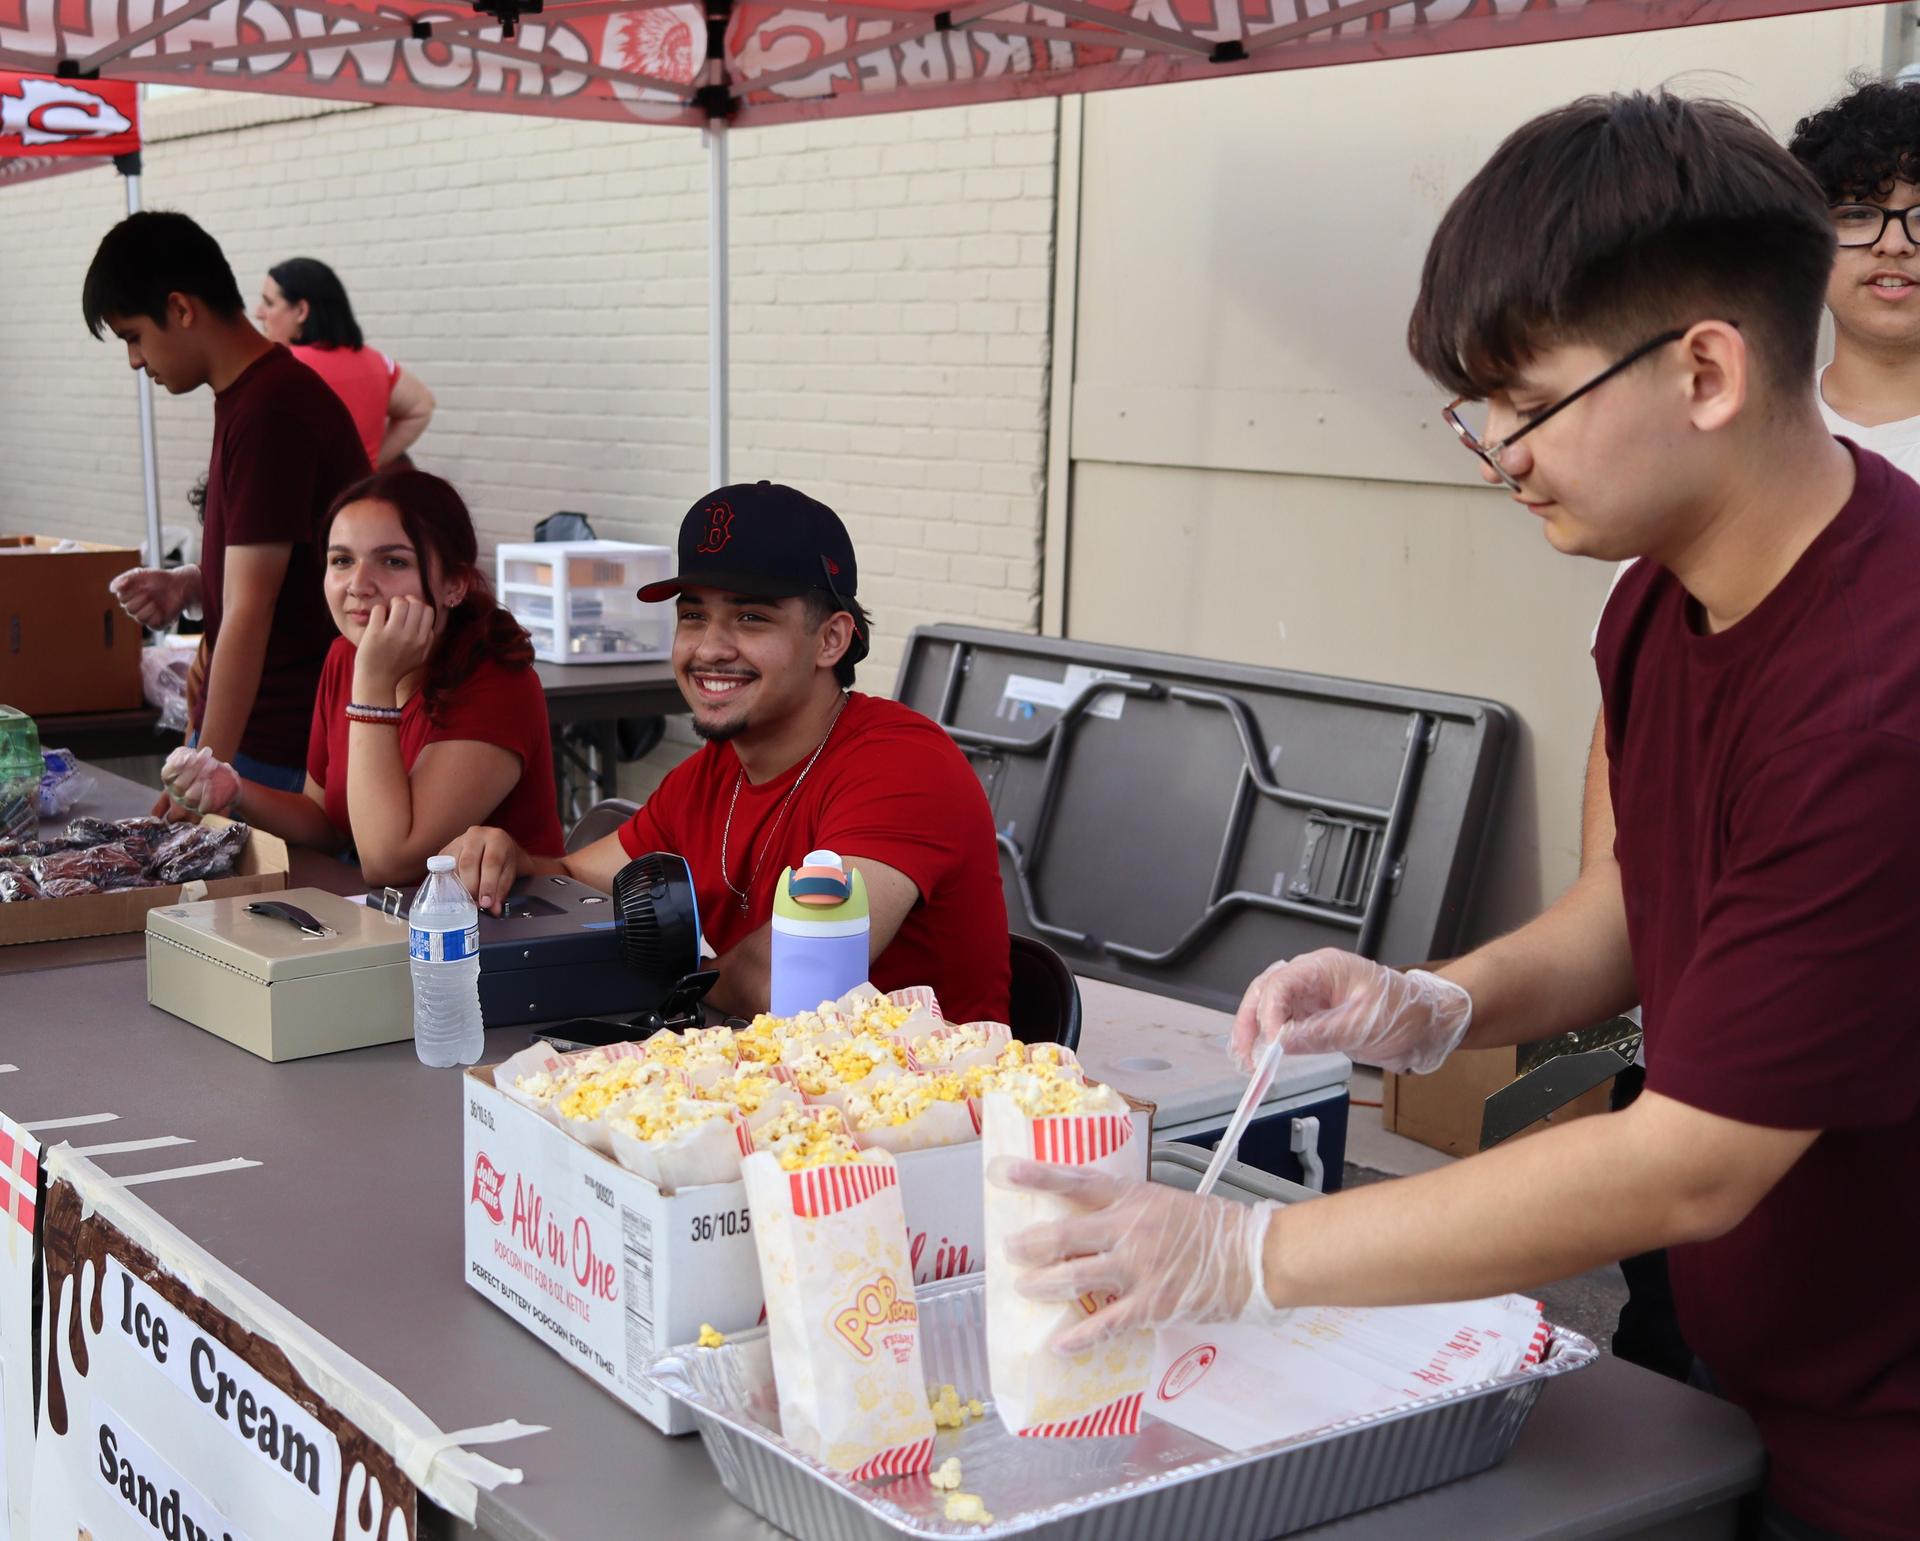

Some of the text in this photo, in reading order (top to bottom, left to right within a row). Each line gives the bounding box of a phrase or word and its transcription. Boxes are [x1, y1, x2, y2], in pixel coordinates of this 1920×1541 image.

[697, 501, 735, 552] B
[477, 1162, 499, 1193] Jolly
[478, 1180, 499, 1210] Time
[511, 1172, 619, 1301] All in One
[691, 1208, 750, 1242] 36/10.5
[935, 1236, 974, 1281] in
[494, 1239, 523, 1273] POPCORN
[523, 1261, 533, 1283] KIT
[535, 1267, 547, 1291] FOR
[567, 1288, 590, 1323] KETTLE
[472, 1261, 615, 1376] PERFECT BUTTERY POPCORN EVERY TIME!
[120, 1272, 320, 1495] Ice Cream
[99, 1423, 233, 1541] Sand
